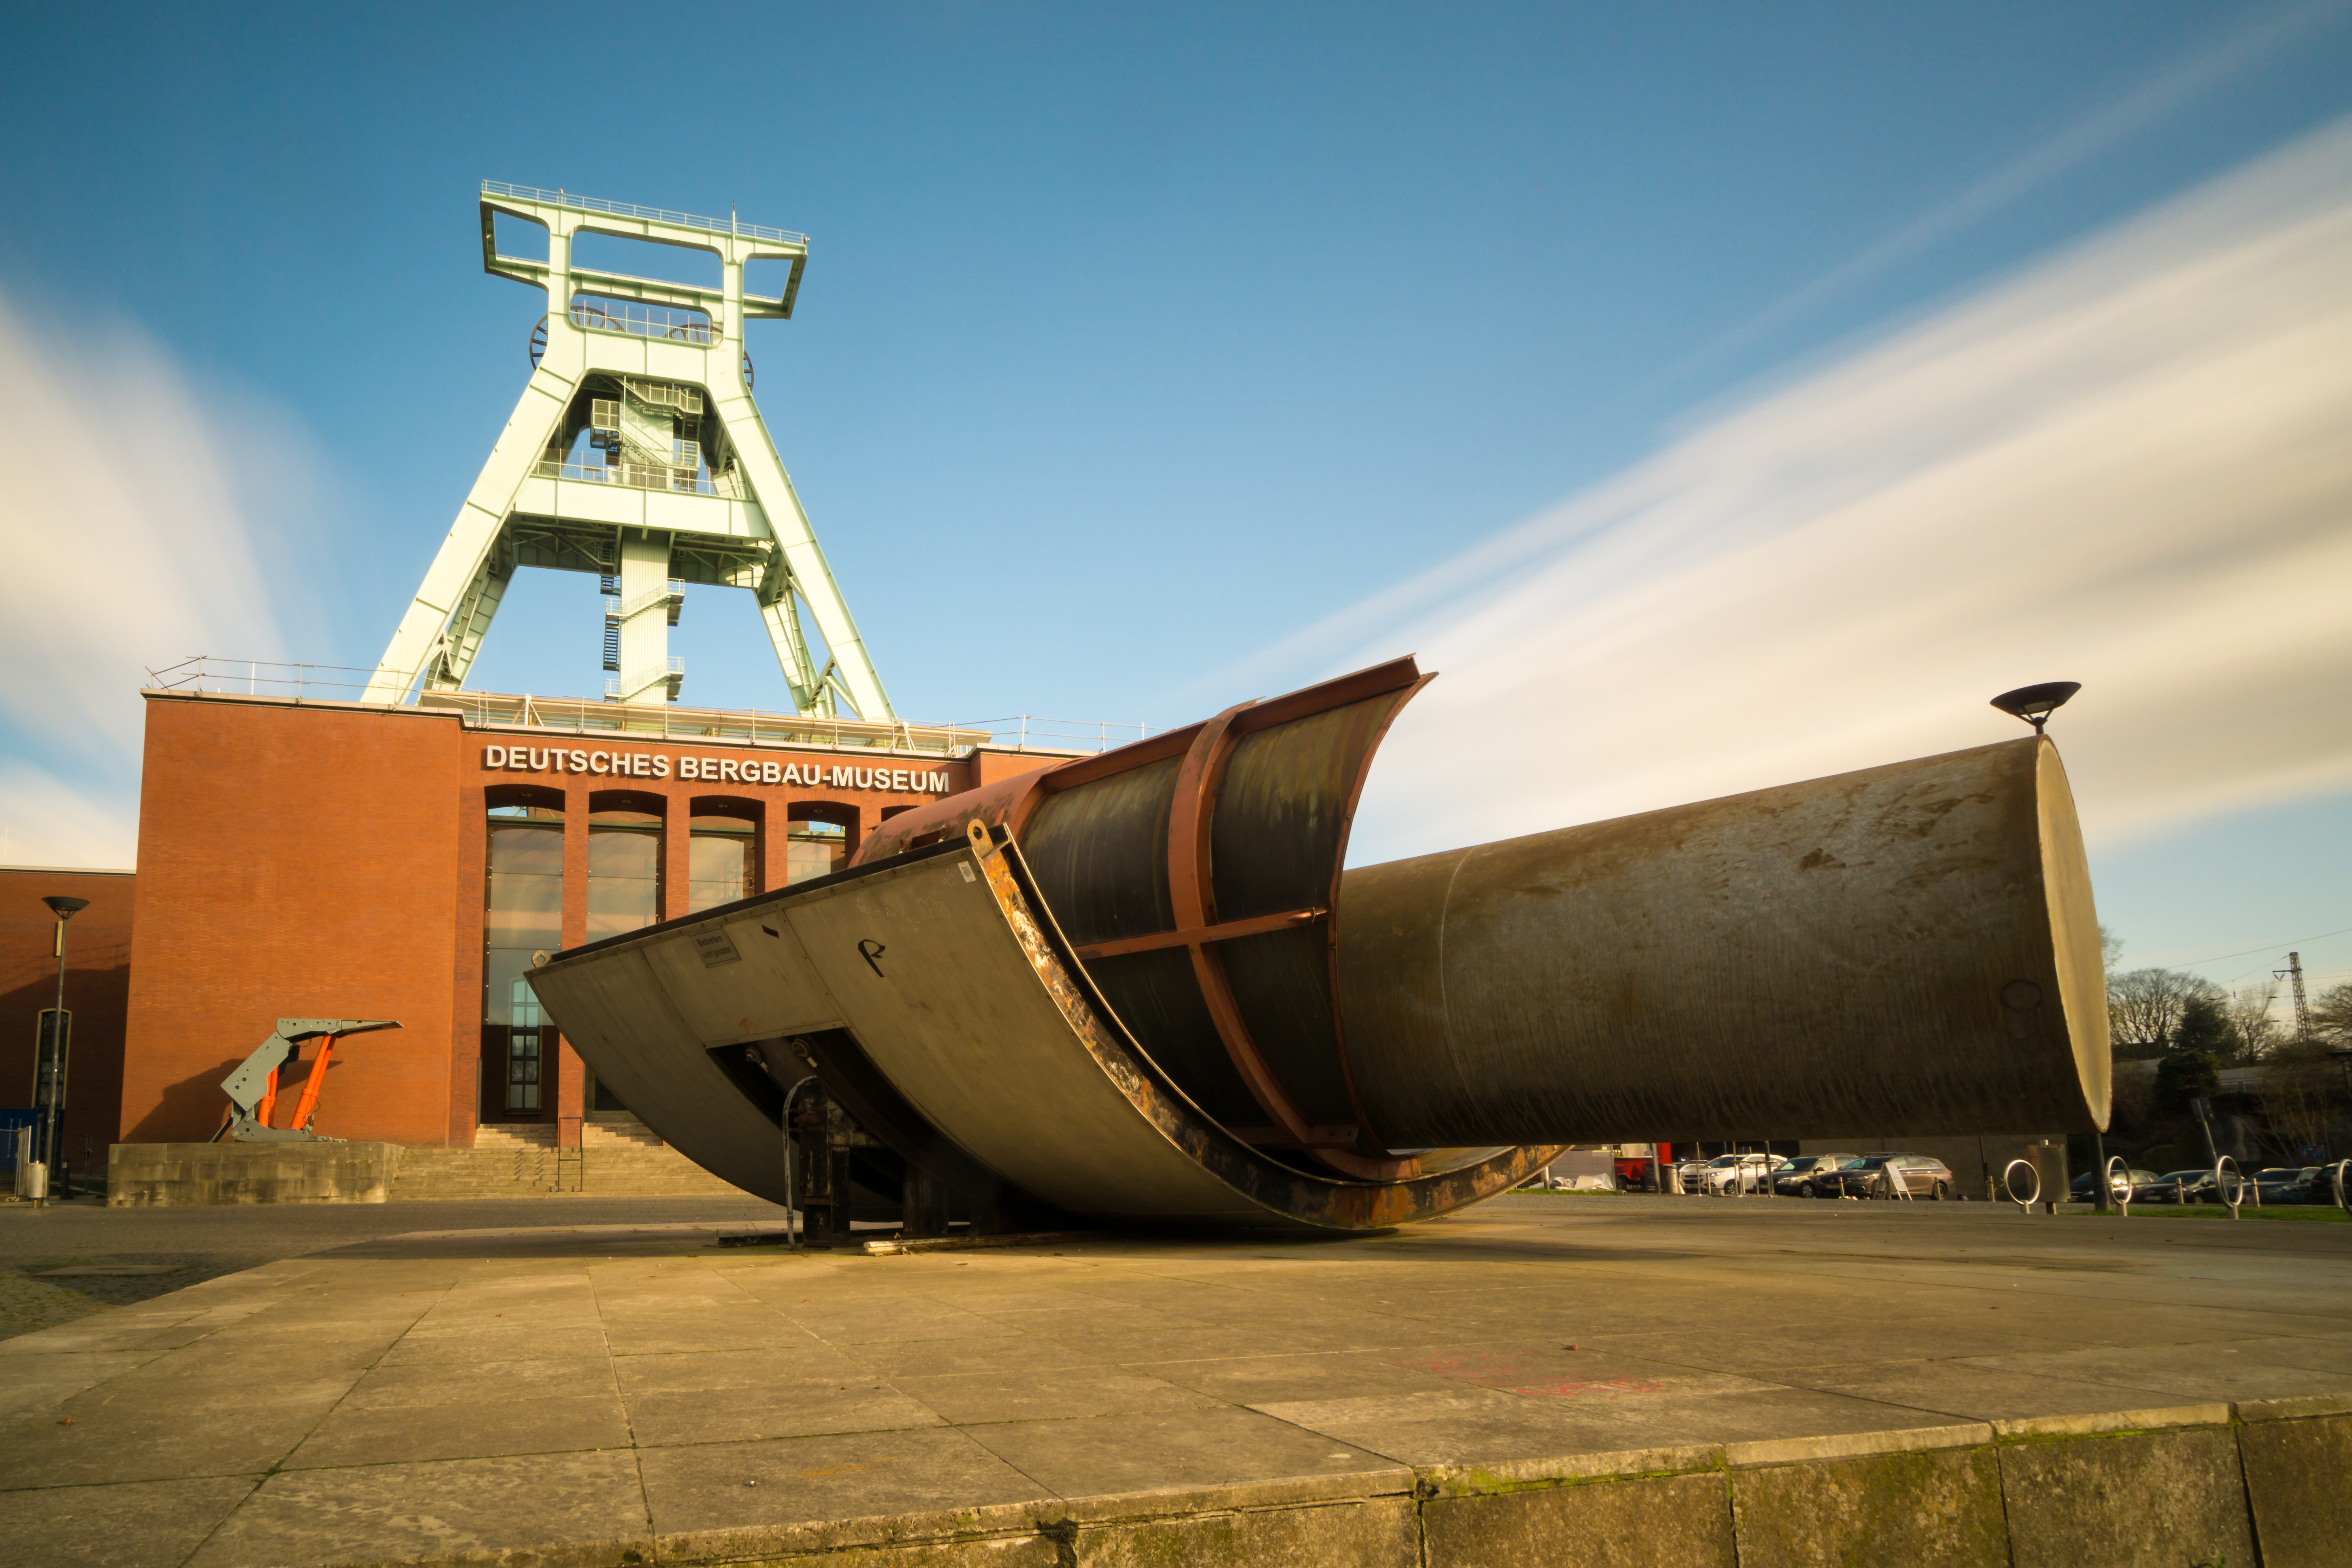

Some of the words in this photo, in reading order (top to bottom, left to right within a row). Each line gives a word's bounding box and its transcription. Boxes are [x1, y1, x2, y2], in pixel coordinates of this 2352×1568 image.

[487, 745, 670, 777] DEUTSCHES
[680, 756, 949, 792] BERGBAU-MUSEUM
[697, 935, 723, 947] Betreten
[702, 951, 714, 959] nicht
[713, 946, 733, 958] gestattet
